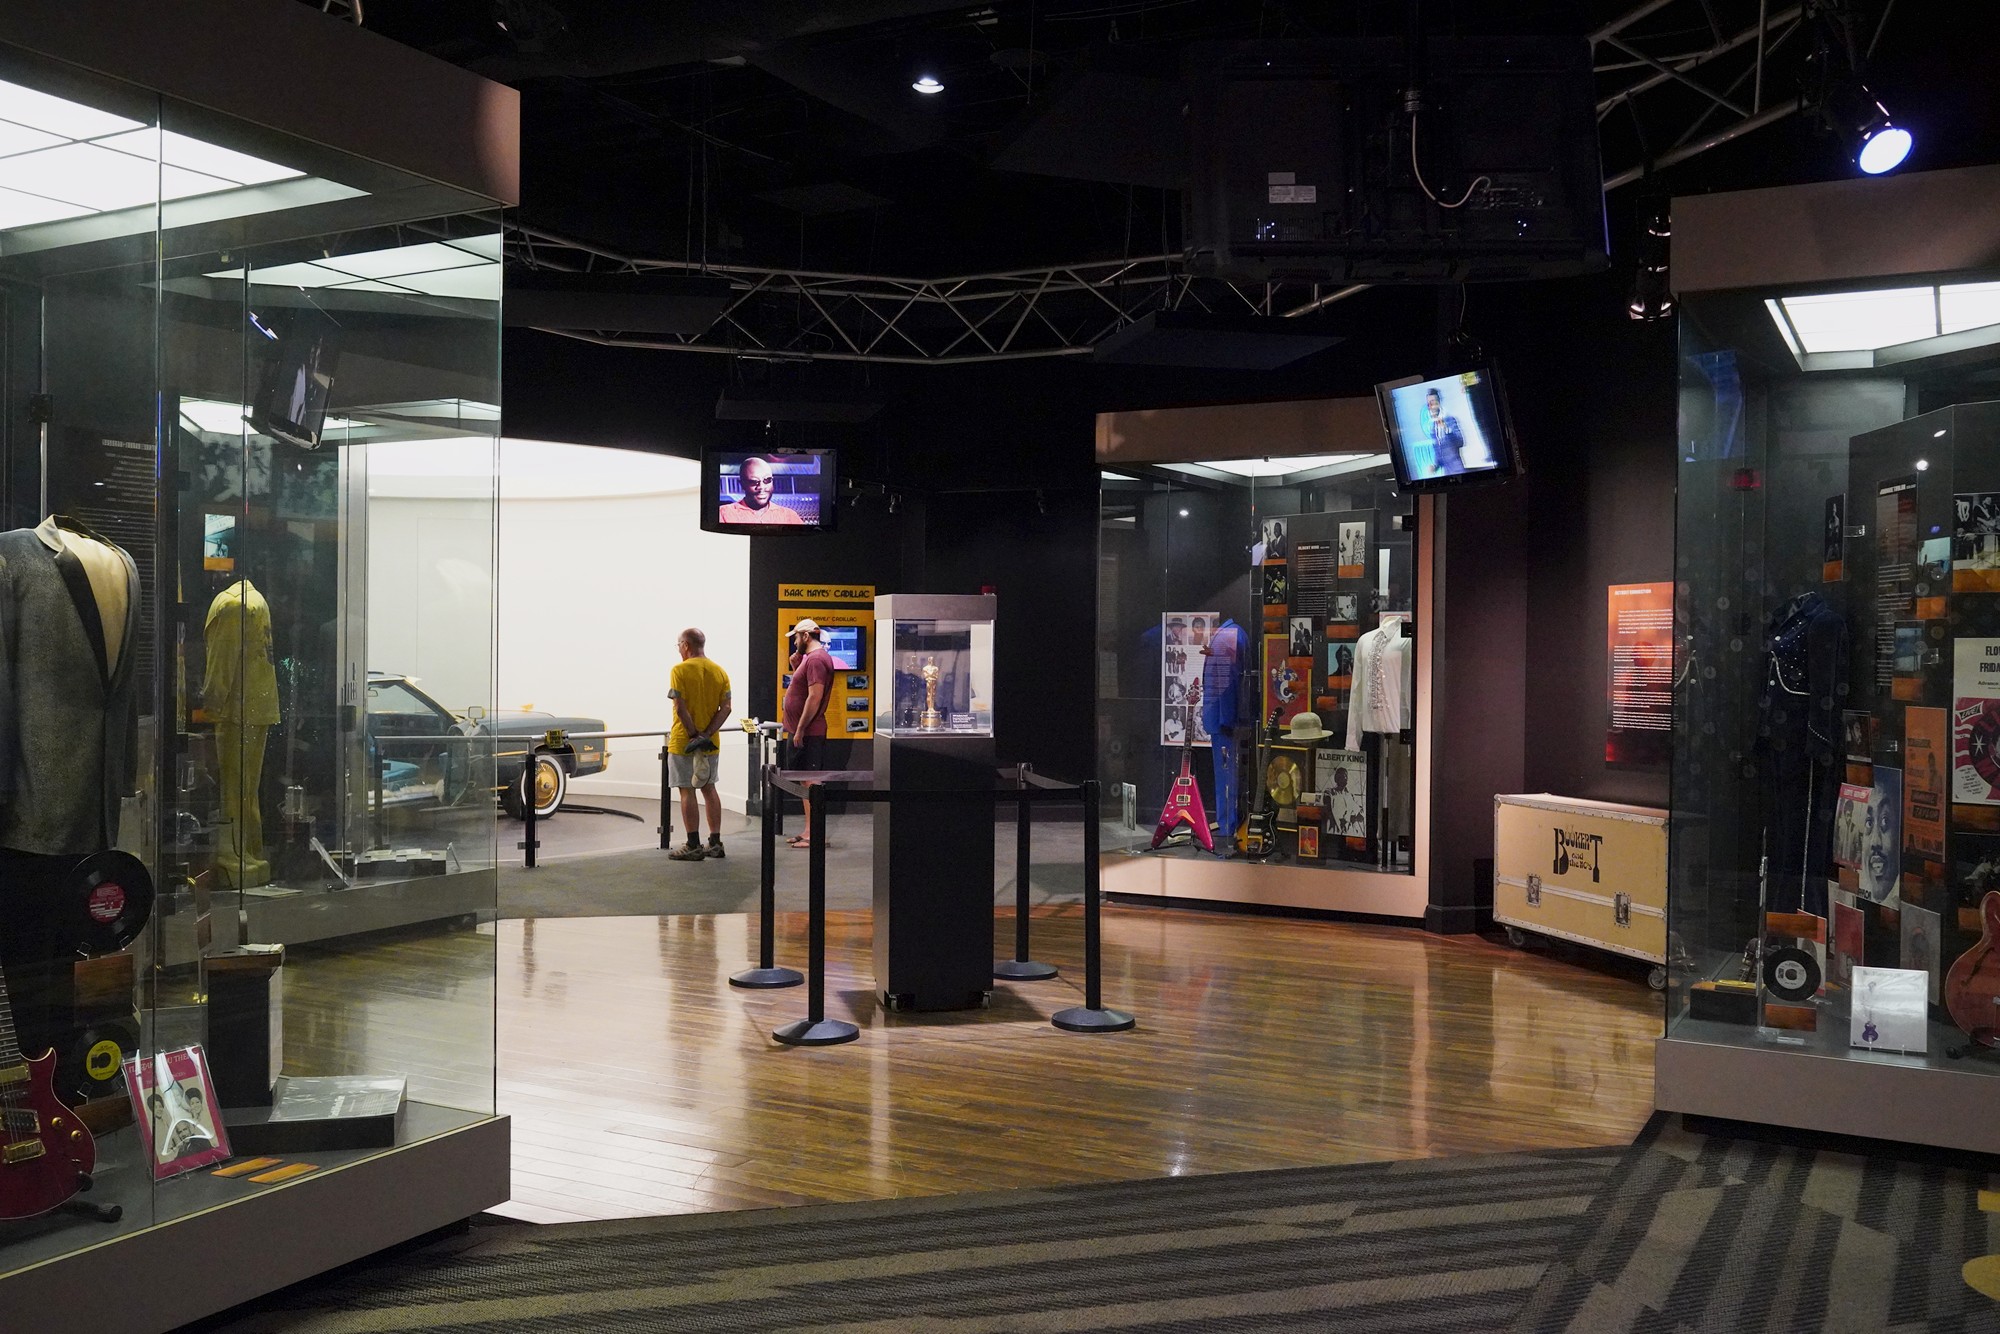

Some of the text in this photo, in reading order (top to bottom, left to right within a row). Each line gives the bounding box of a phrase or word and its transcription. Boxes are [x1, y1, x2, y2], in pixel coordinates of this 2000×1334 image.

[784, 588, 870, 599] ISAAC HAYES' CADILLAC
[1985, 645, 2000, 656] FLO
[1317, 753, 1365, 763] ALBERT KING
